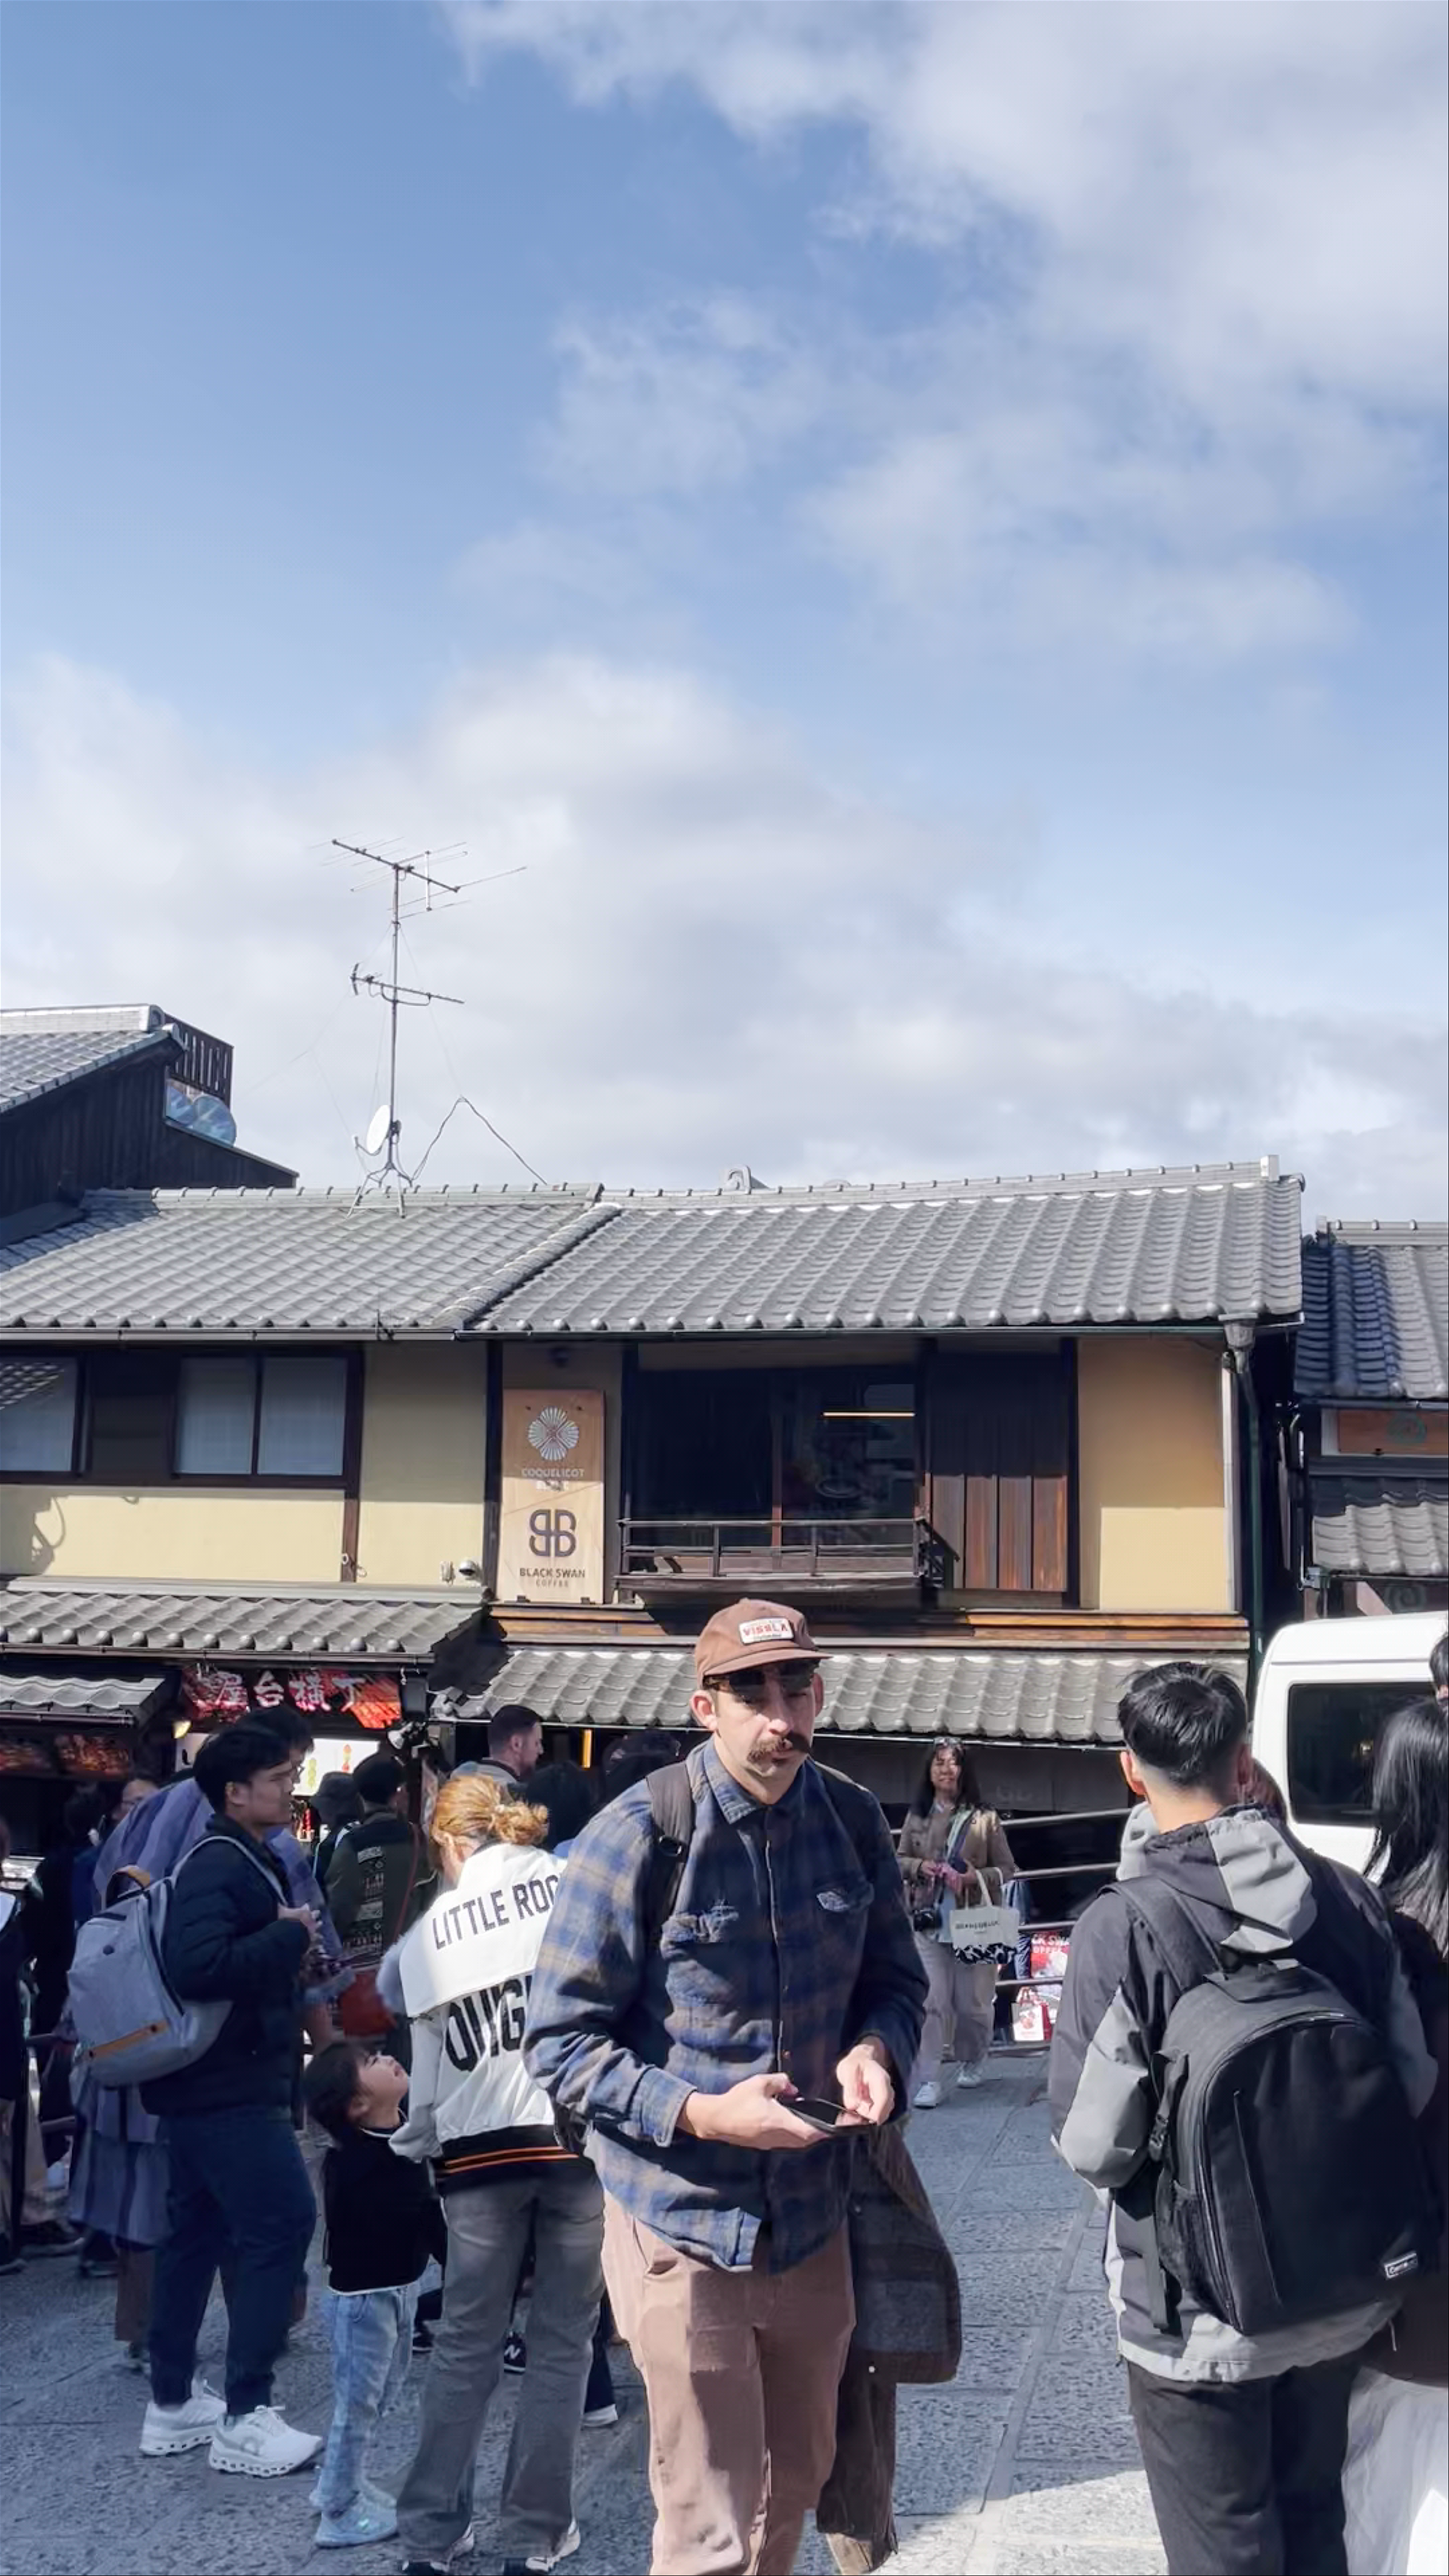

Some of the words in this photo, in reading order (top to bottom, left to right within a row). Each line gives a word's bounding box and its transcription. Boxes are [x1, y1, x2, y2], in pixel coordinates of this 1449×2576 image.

[521, 1468, 584, 1477] COQUELICOT
[520, 1567, 553, 1578] BLACK
[556, 1568, 585, 1578] SWAN
[432, 1890, 510, 1950] LITTLE
